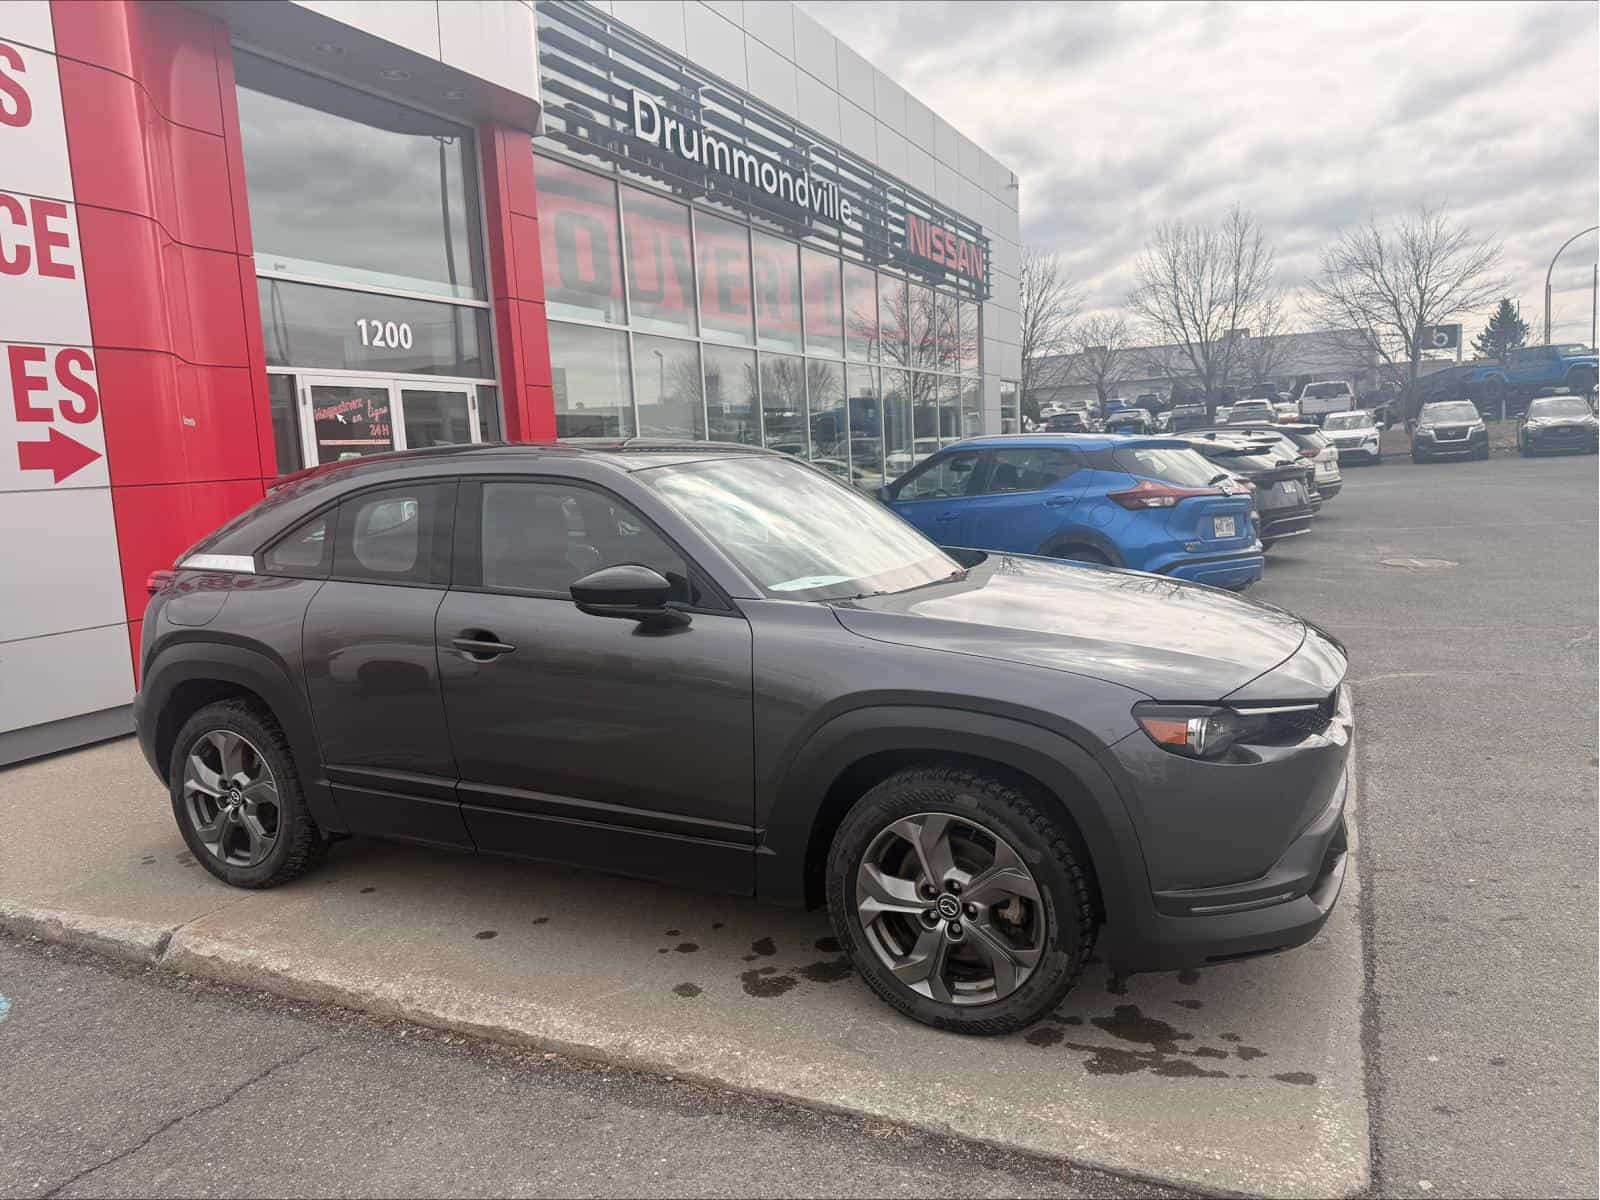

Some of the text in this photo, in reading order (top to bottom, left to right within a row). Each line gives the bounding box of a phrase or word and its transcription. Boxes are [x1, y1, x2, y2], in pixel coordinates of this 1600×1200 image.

[631, 88, 852, 227] Drummondville
[905, 214, 985, 281] NISSAN
[356, 318, 413, 349] 1200
[7, 345, 100, 425] ES
